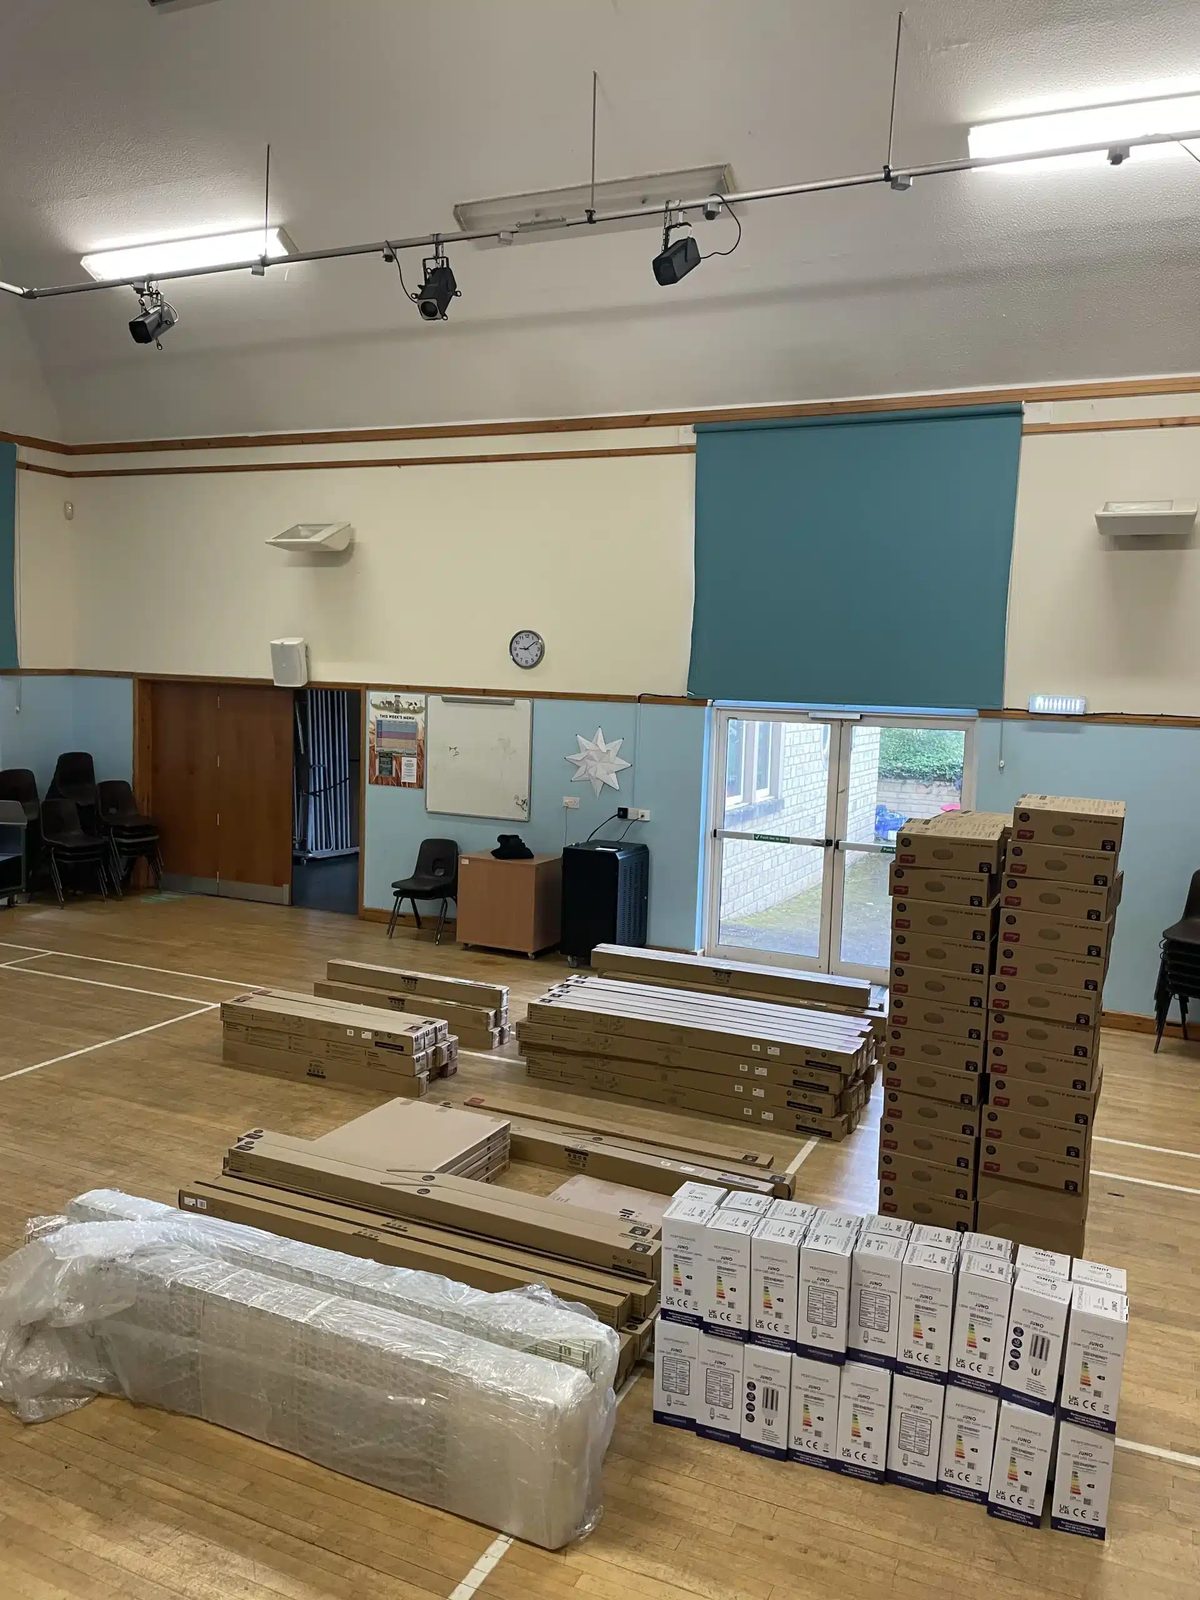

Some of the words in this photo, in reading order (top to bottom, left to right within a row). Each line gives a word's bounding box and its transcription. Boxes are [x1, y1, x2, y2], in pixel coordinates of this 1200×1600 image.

[919, 1293, 933, 1301] JUNO
[975, 1302, 989, 1310] JUNO
[1030, 1320, 1044, 1328] JUNO
[917, 1352, 929, 1363] CE
[969, 1362, 982, 1373] CE
[1082, 1400, 1096, 1411] CE
[806, 1440, 818, 1450] CE
[854, 1451, 867, 1462] CE
[958, 1472, 970, 1482] CE
[1010, 1494, 1023, 1505] CE
[1073, 1508, 1086, 1518] CE
